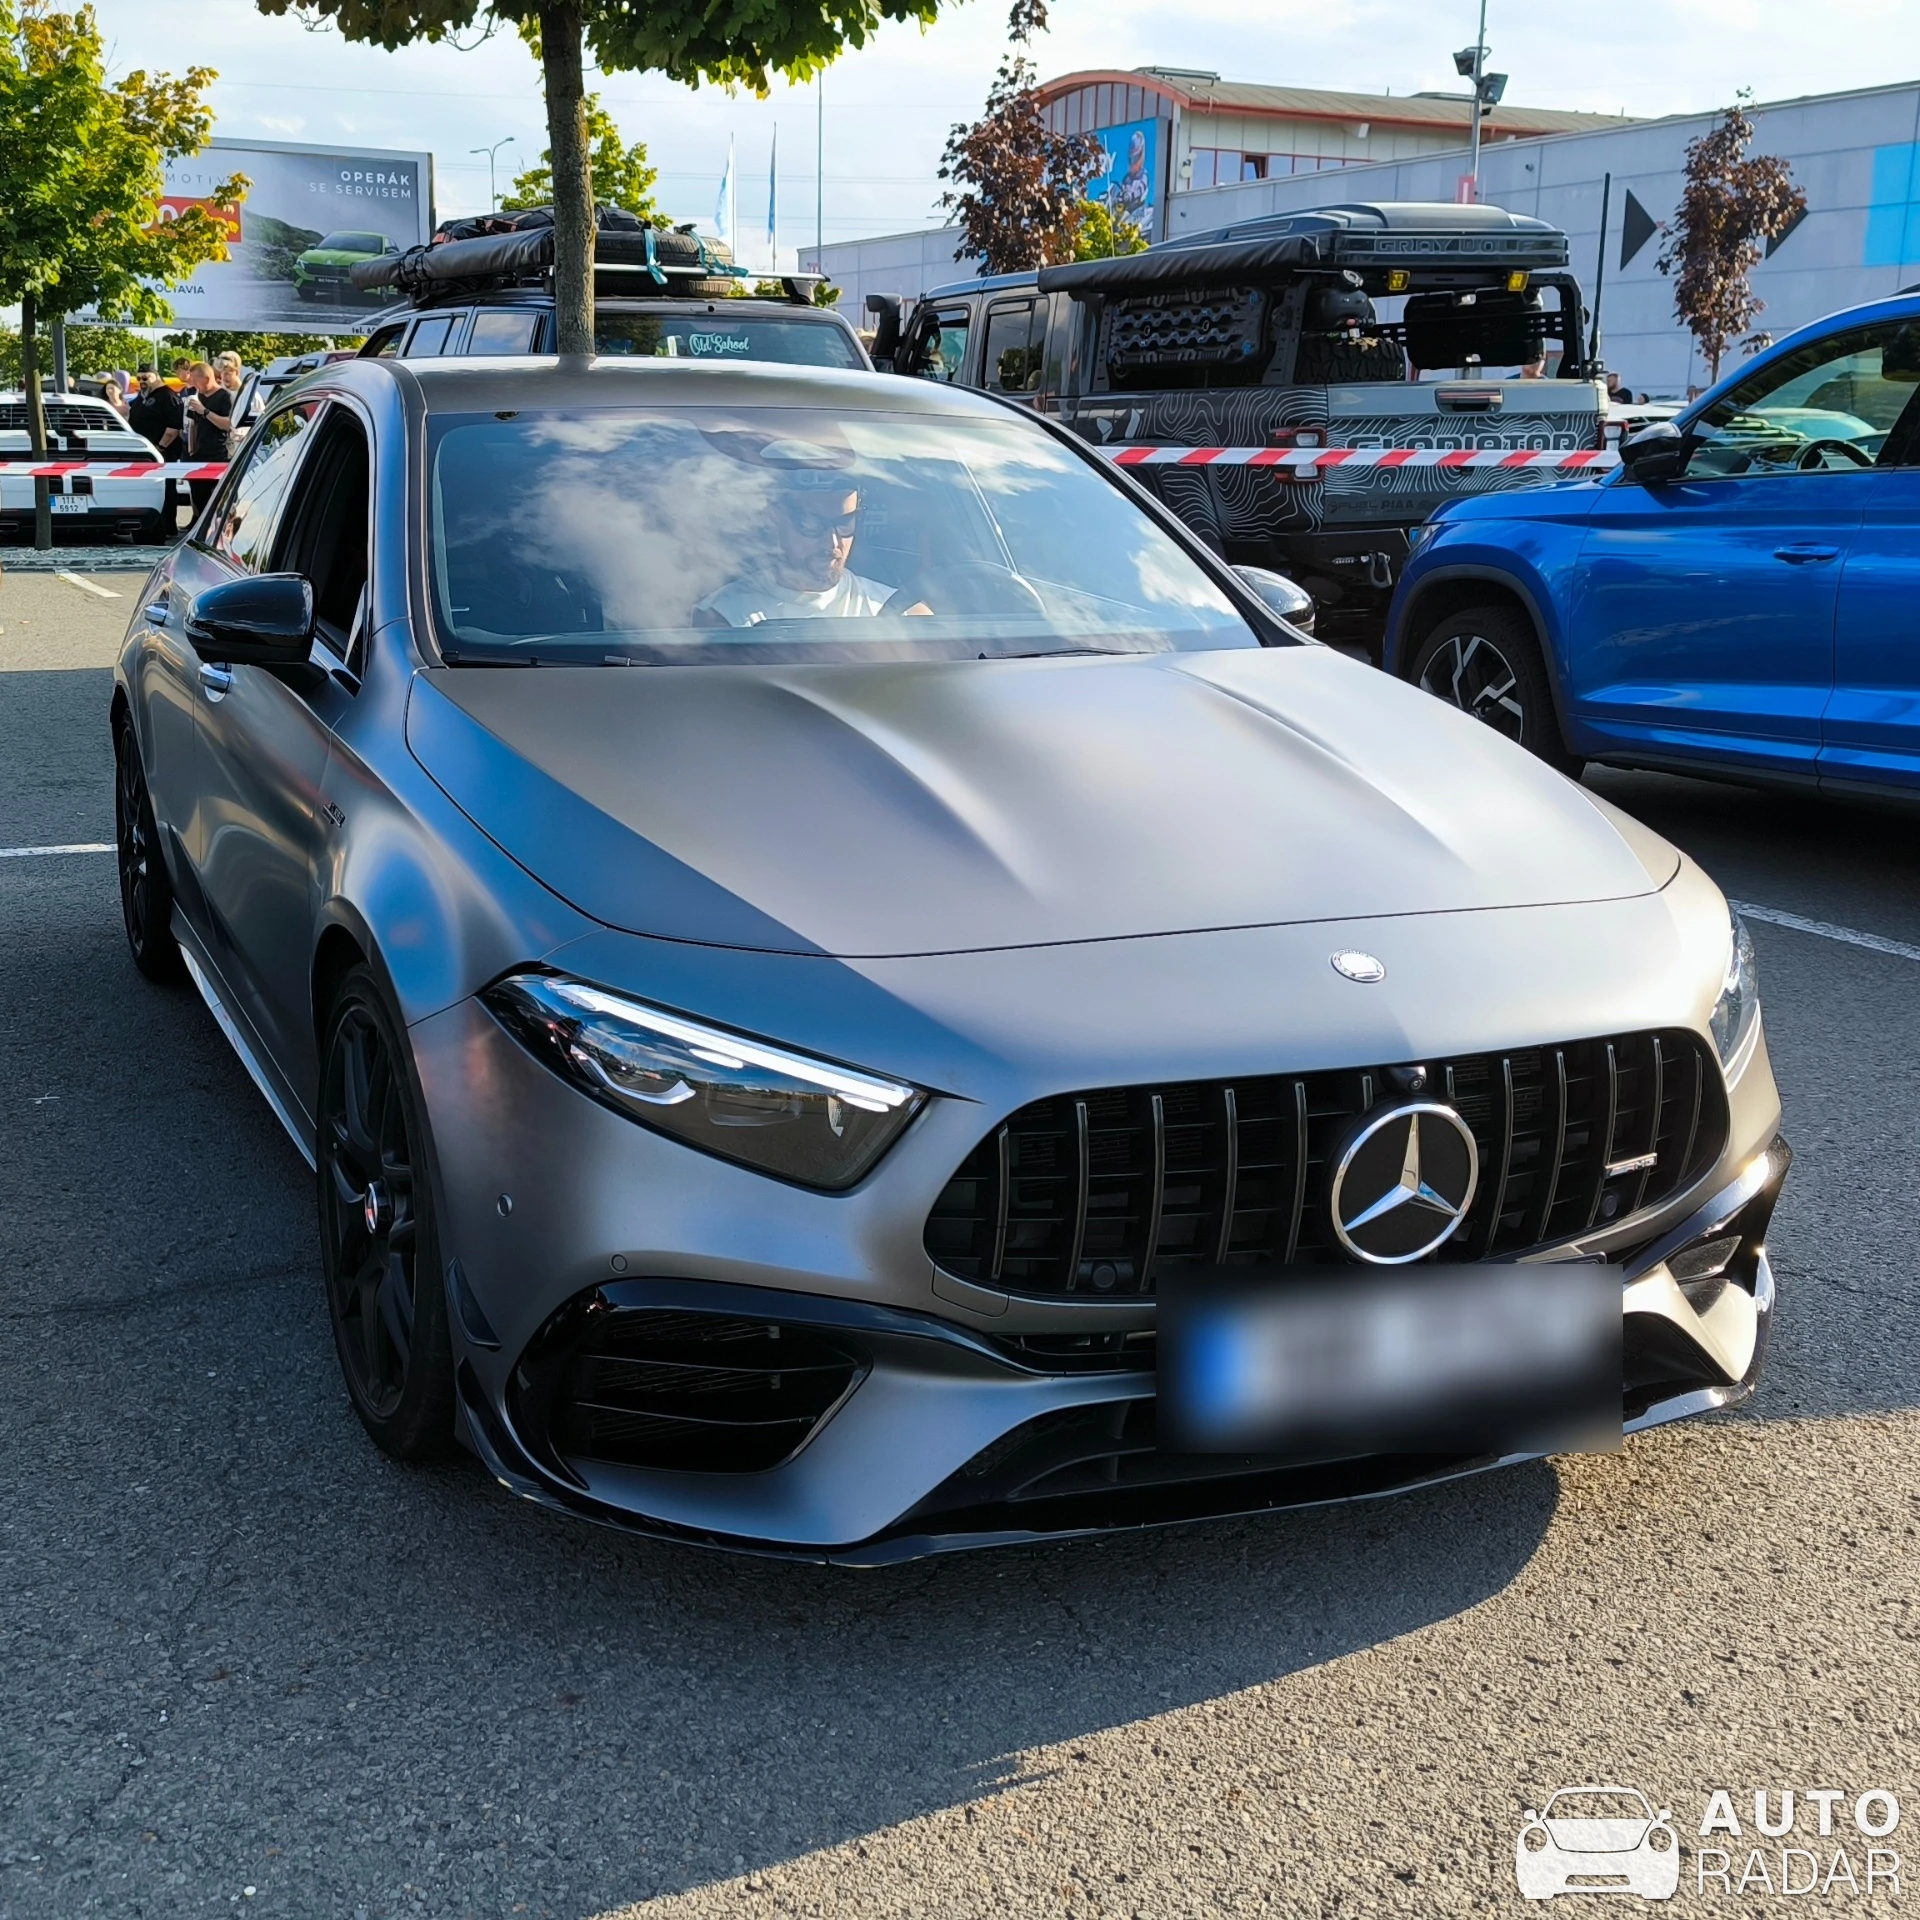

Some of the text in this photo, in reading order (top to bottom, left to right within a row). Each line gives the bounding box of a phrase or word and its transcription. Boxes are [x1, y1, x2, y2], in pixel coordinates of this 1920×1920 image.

[165, 173, 228, 185] MOTIV
[340, 170, 410, 186] OPERÁK
[309, 182, 411, 199] SE SERVISEM
[1374, 238, 1453, 253] GRAY
[154, 283, 205, 295] OCTAVIA
[689, 332, 750, 355] Old School
